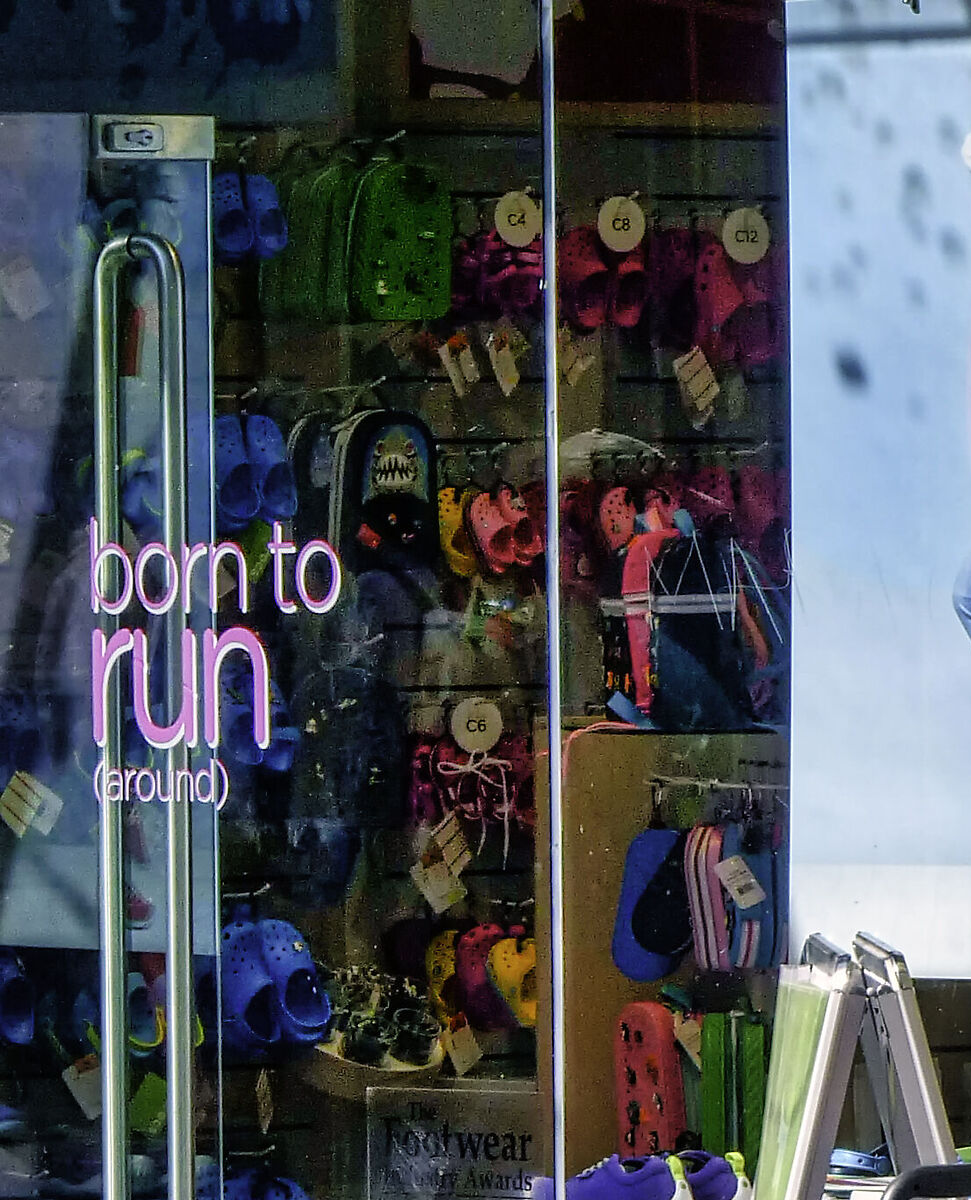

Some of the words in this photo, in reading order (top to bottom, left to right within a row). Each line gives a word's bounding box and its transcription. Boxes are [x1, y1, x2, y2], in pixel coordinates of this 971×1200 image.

[507, 213, 526, 227] C4
[611, 218, 631, 232] C8
[735, 231, 758, 243] C12
[90, 516, 248, 615] born
[268, 521, 342, 615] to
[92, 624, 271, 750] run
[467, 719, 487, 733] C6
[94, 758, 229, 811] (around)
[464, 1169, 533, 1192] Awards
